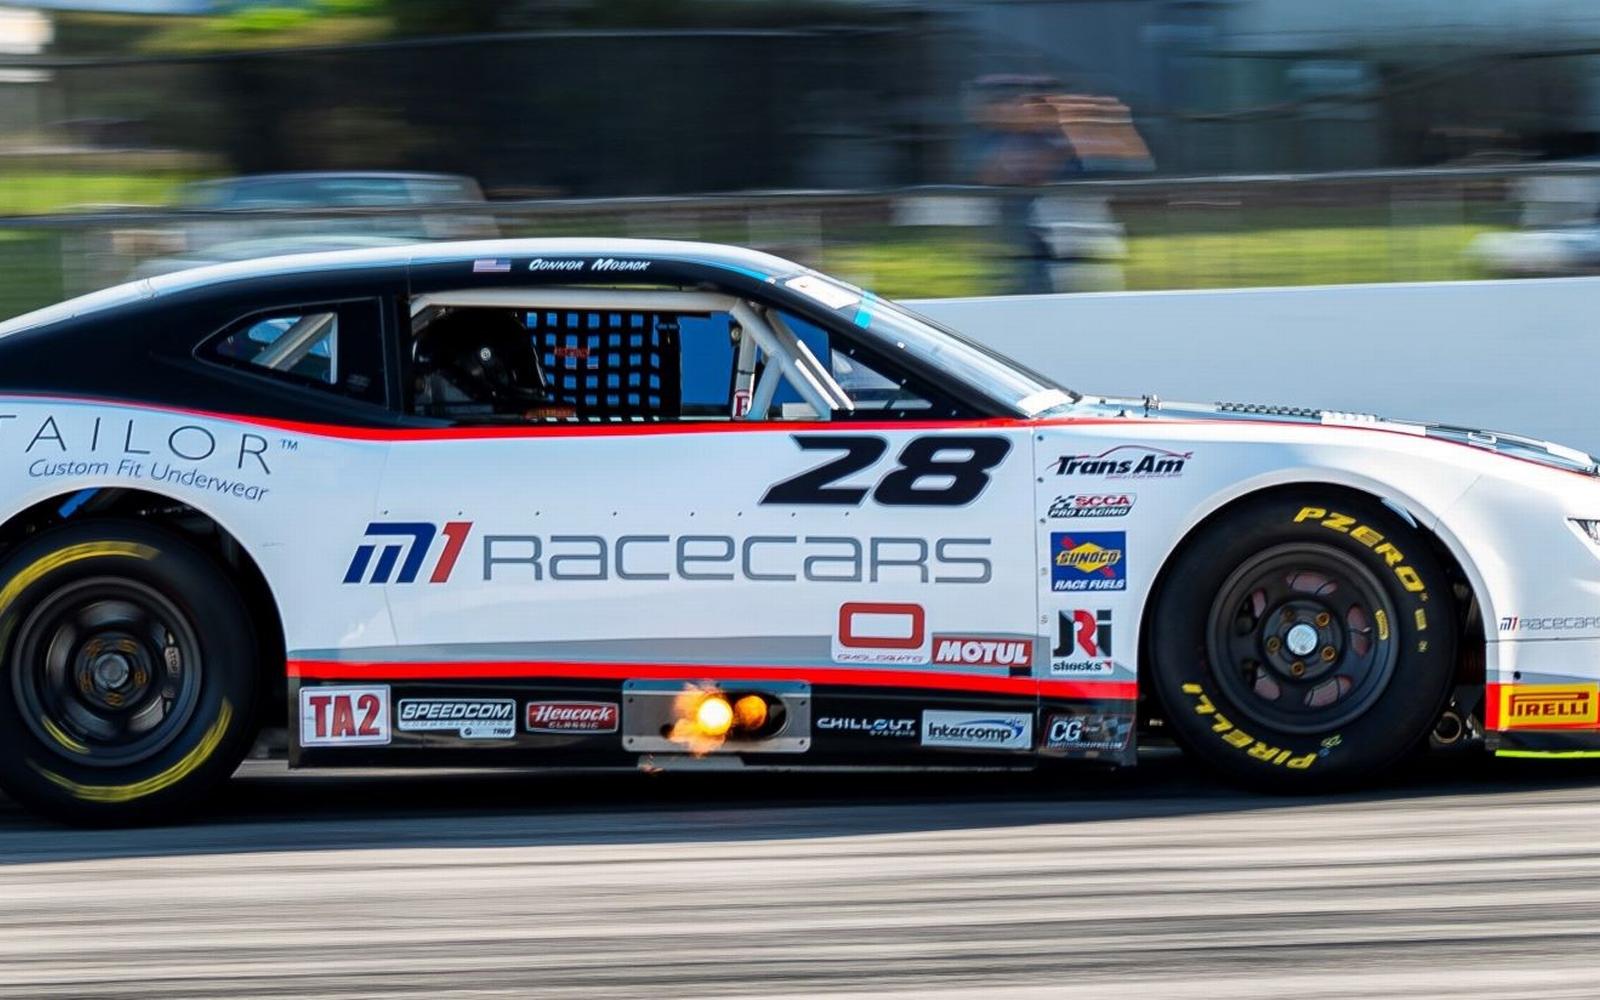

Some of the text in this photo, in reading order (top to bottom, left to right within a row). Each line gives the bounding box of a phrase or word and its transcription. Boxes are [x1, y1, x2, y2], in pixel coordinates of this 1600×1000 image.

[760, 435, 1012, 507] 28
[1056, 455, 1184, 475] Trans Am
[28, 458, 269, 502] Custom Fit Underwear
[1075, 495, 1131, 506] SCCA
[1049, 507, 1127, 517] PRO RACING
[1058, 551, 1120, 564] SUNOCO
[1054, 579, 1125, 590] RACE FUELS
[936, 641, 1028, 664] MOTUL
[1053, 661, 1101, 671] shocks
[402, 703, 512, 719] SPEEDCOM
[535, 705, 612, 722] Heacock
[1508, 692, 1590, 717] PIRELLI
[309, 694, 381, 738] TA2
[816, 717, 916, 730] CHILLOUT
[1182, 683, 1317, 769] PIRELLI
[928, 721, 1012, 743] Intercomp
[1050, 720, 1082, 742] CG
